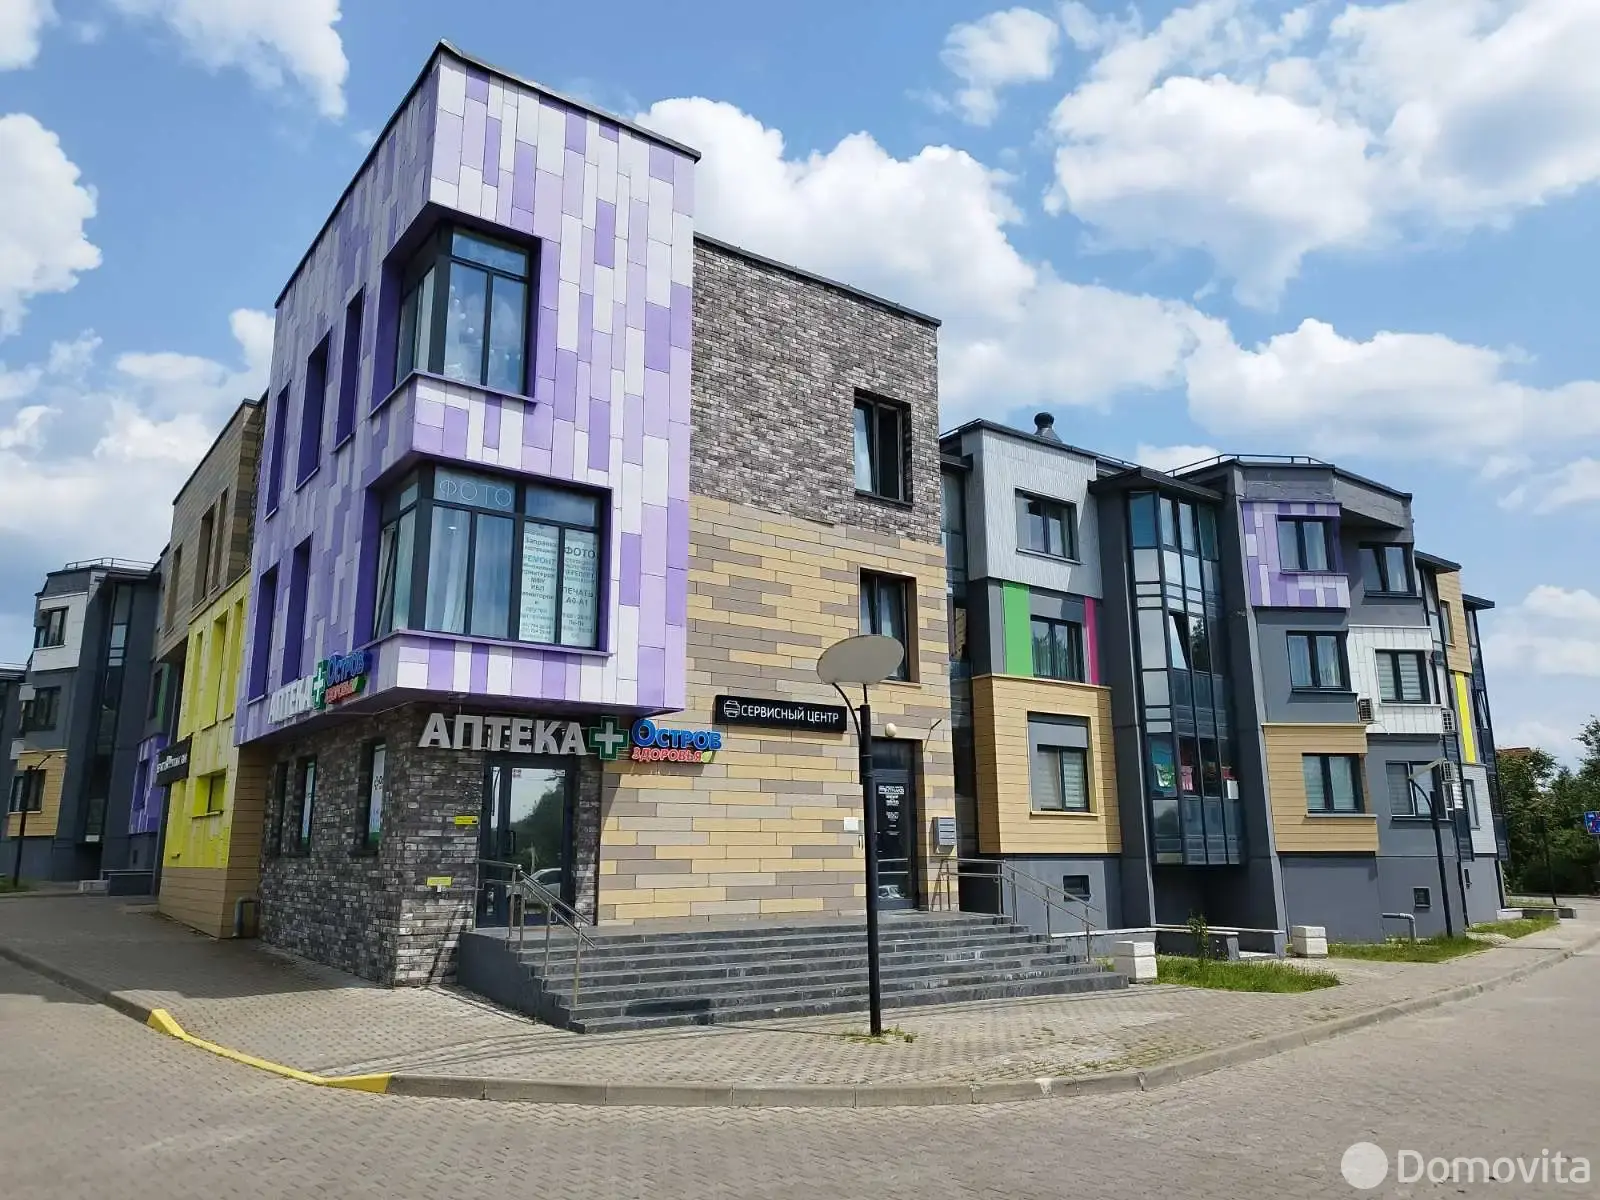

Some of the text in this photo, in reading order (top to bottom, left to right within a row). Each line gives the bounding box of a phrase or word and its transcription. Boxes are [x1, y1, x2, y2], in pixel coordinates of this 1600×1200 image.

[439, 480, 512, 506] ФОТО
[564, 546, 596, 558] ФОТО
[563, 586, 594, 598] ПЕЧАТЬ
[741, 704, 839, 723] СЕРВИСНЫЙ ЦЕНТР
[417, 712, 589, 756] АПТЕКА
[632, 747, 703, 763] ЗДОРОВЬЯ
